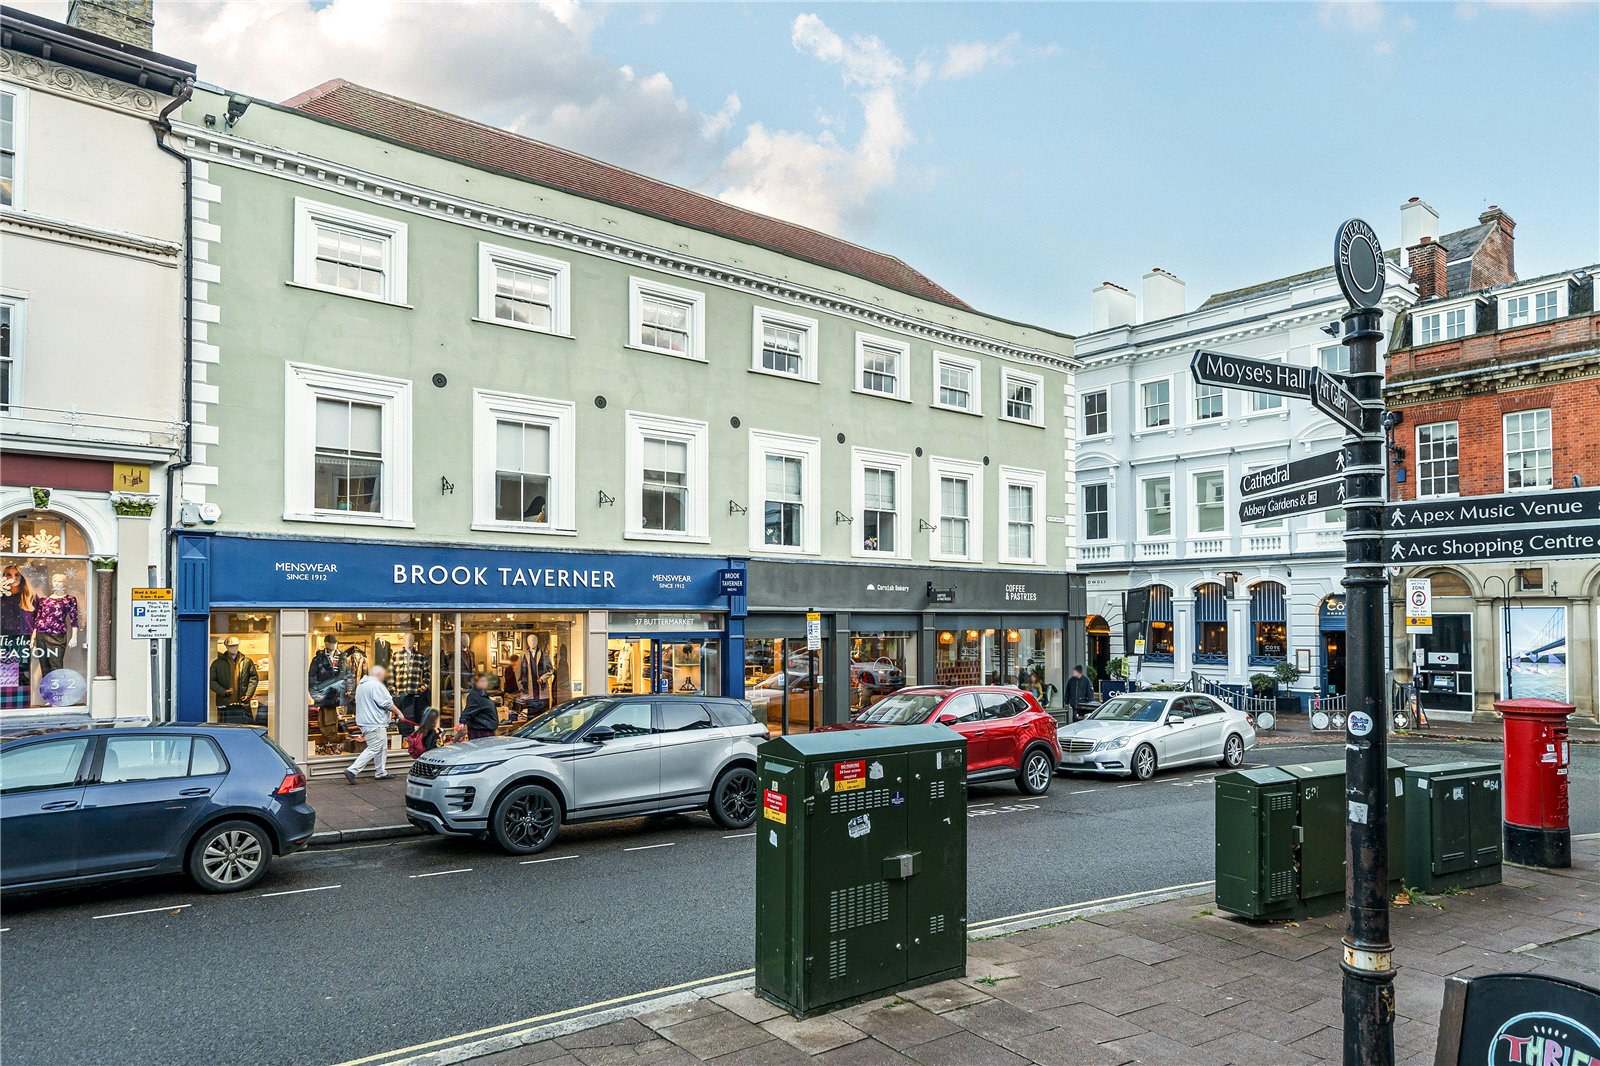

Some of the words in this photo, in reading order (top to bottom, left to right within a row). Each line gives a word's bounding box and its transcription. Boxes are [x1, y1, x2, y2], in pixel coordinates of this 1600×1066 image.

[1342, 221, 1384, 280] BUTTERMARKET
[1206, 356, 1272, 384] Moyse's
[1277, 366, 1305, 389] Hall
[1320, 375, 1329, 400] Art
[1331, 384, 1348, 418] Gallery
[1243, 464, 1290, 491] Cathedral
[1244, 504, 1266, 516] Abbey
[1268, 498, 1298, 512] Gardens
[1300, 495, 1306, 505] &
[1410, 510, 1454, 526] Apex
[1460, 504, 1515, 520] Music
[1520, 501, 1583, 516] Venue
[1408, 543, 1437, 556] Arc
[1442, 538, 1524, 557] Shopping
[1529, 534, 1594, 550] Centre
[276, 562, 337, 572] MENSWEAR
[393, 565, 488, 585] BROOK
[498, 568, 616, 588] TAVERNER
[1005, 584, 1025, 592] COFFEE
[1327, 602, 1346, 610] CÔ
[15, 635, 31, 646] the
[0, 648, 58, 658] EASON
[50, 679, 60, 690] 3
[67, 679, 76, 688] 2
[1499, 1034, 1600, 1066] THRIF
